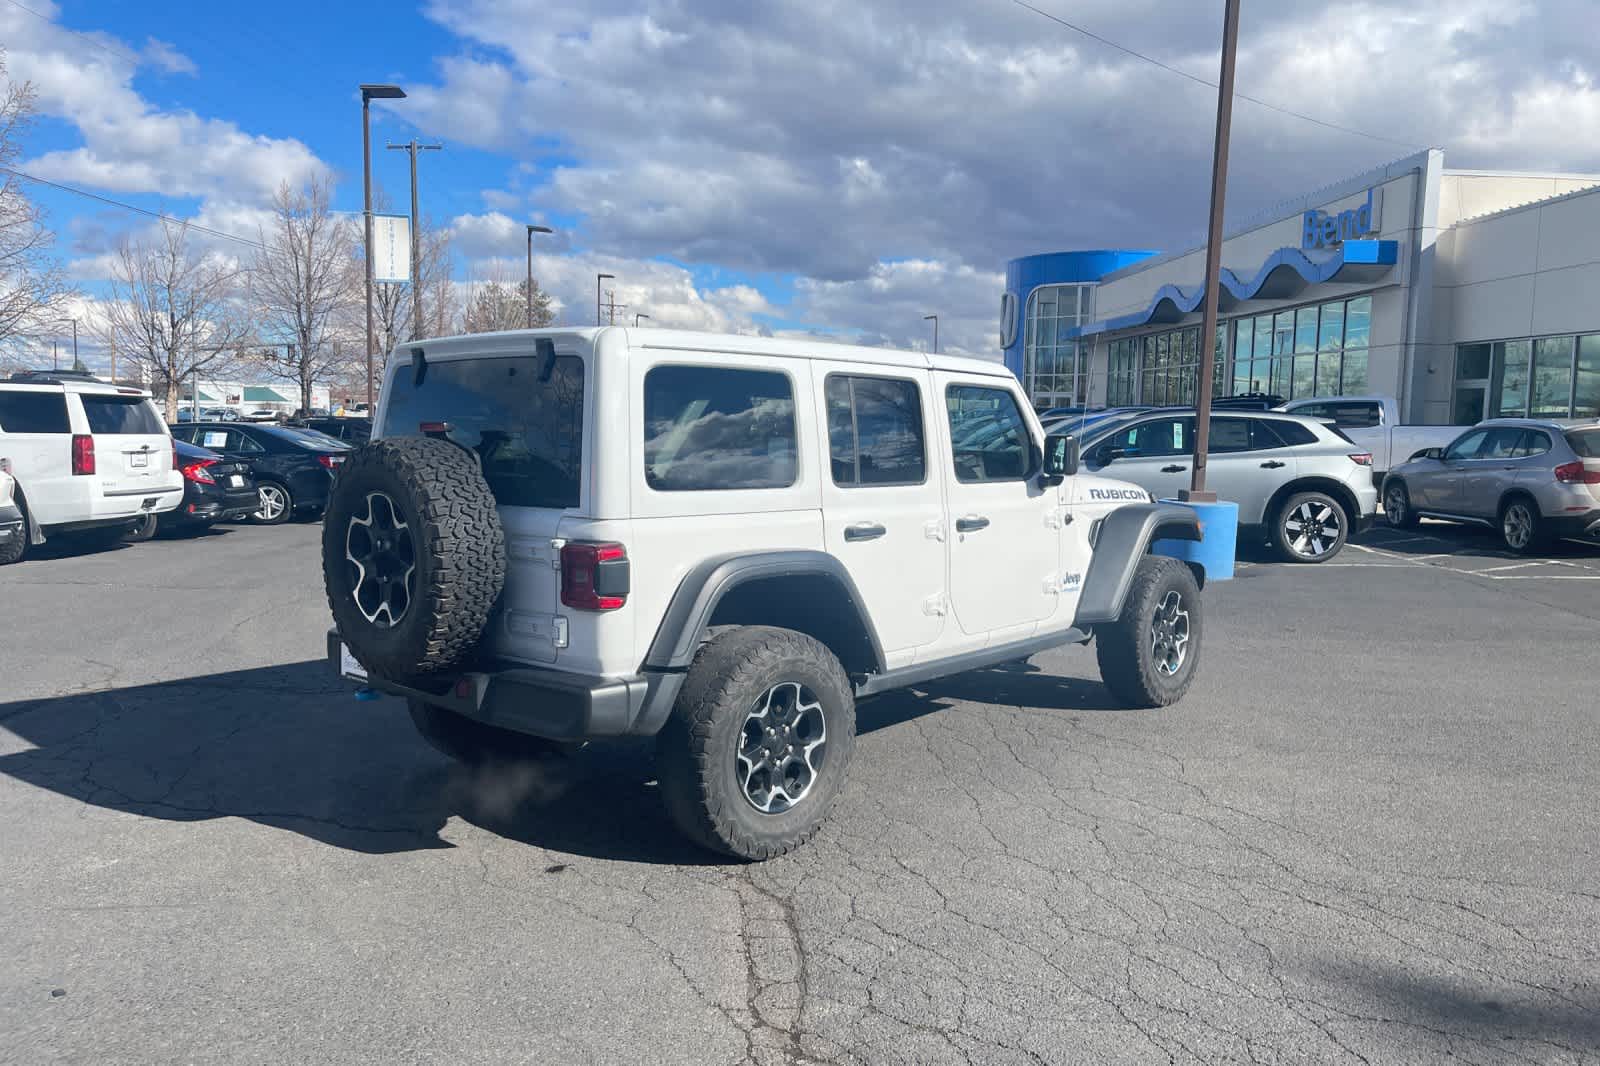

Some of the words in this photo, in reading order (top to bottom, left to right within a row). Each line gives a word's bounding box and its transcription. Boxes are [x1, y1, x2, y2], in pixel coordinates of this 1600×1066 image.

[1303, 187, 1373, 249] Bend
[1089, 488, 1146, 500] RUBICON
[1063, 571, 1081, 585] Jeep
